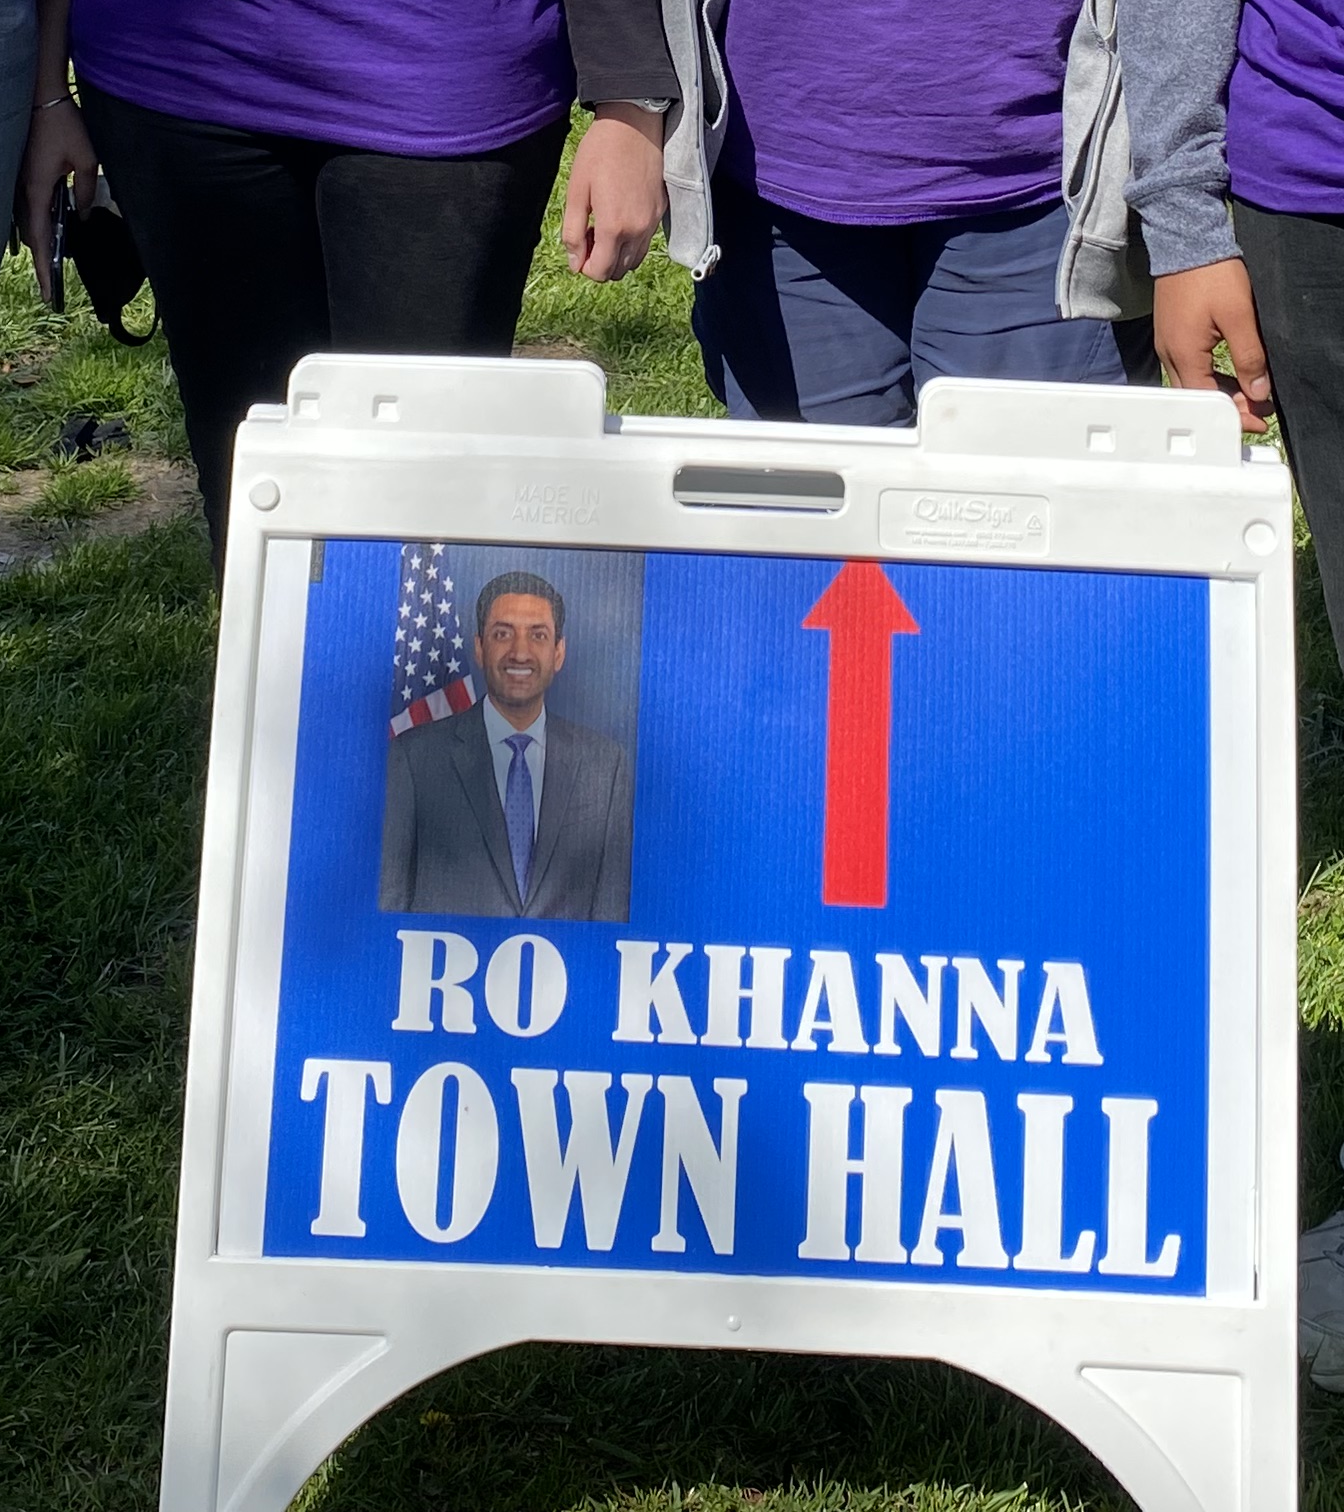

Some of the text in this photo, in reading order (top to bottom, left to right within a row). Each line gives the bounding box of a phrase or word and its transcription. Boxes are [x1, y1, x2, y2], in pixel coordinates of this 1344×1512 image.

[513, 485, 600, 505] MADE IN
[512, 504, 601, 525] AMERICA
[915, 496, 1014, 528] QuikSign
[391, 928, 1104, 1066] RO KHANNA
[300, 1057, 1181, 1277] TOWN HALL
